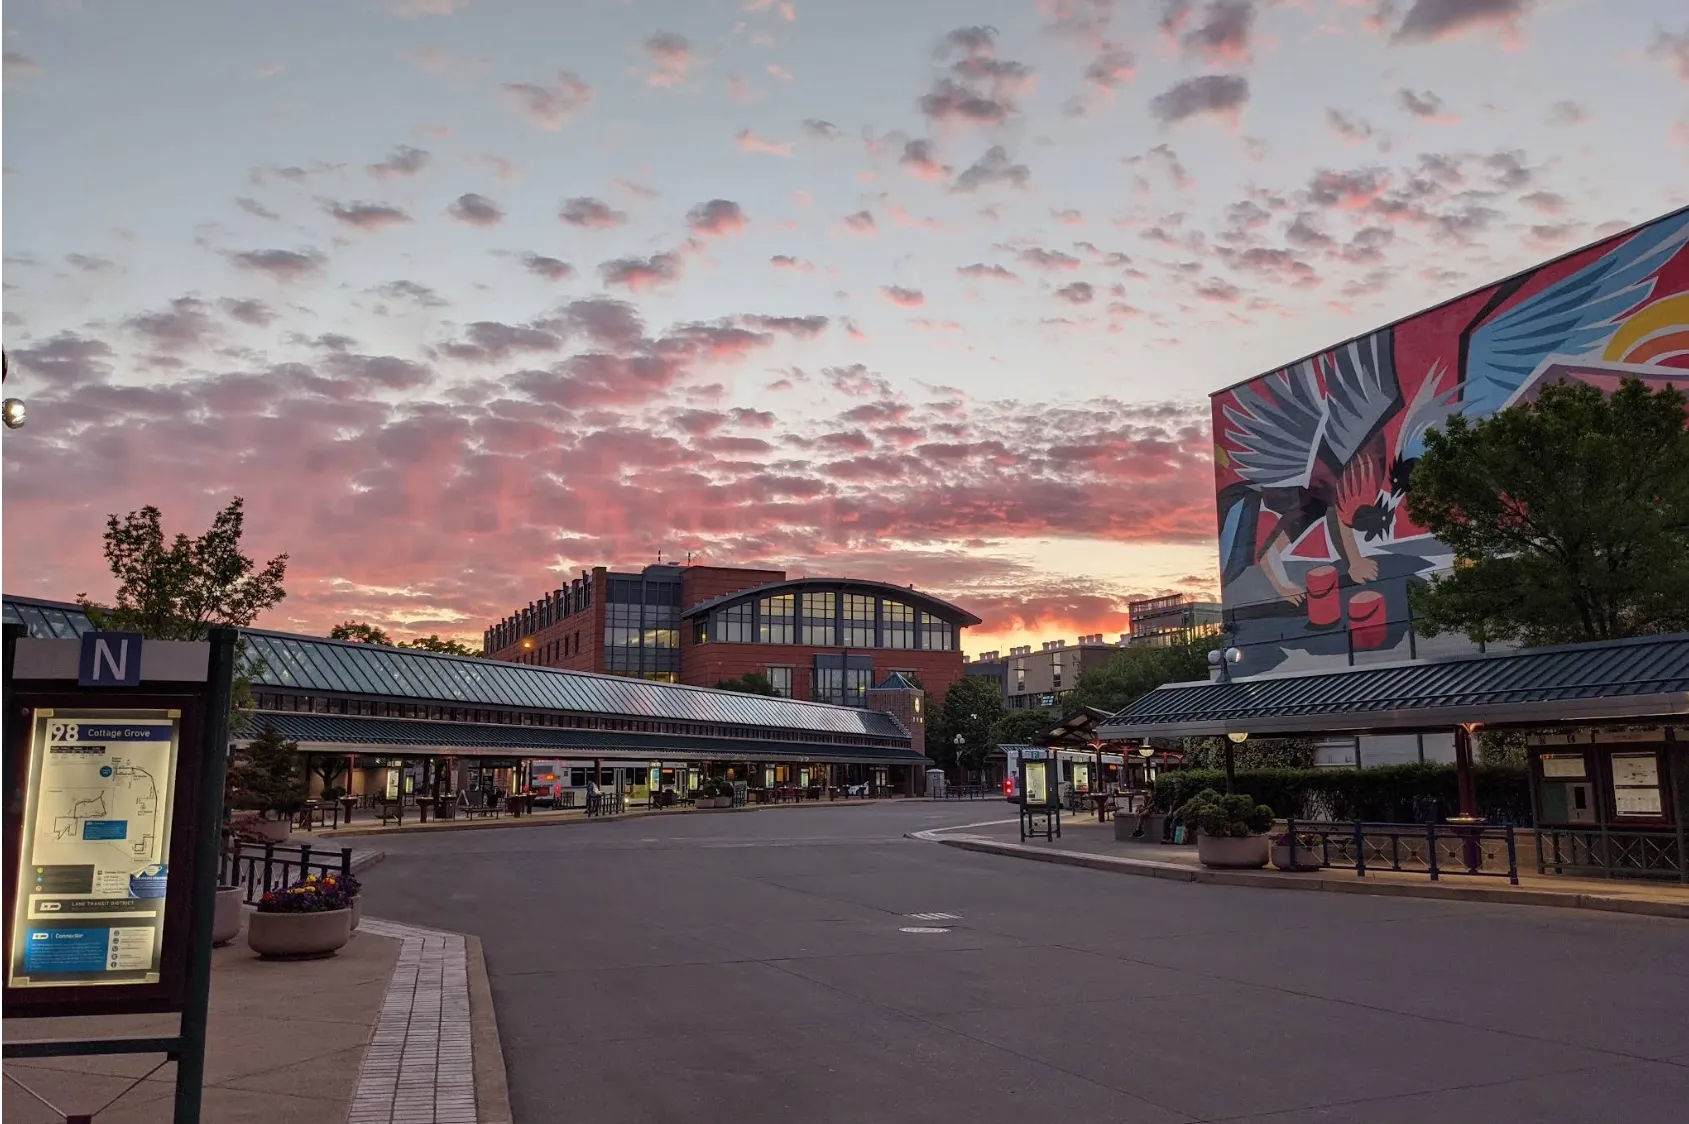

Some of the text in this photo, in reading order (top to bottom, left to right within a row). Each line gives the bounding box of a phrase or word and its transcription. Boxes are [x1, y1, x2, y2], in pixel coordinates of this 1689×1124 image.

[92, 638, 129, 681] N
[52, 724, 151, 741] 98 Cottage Grove
